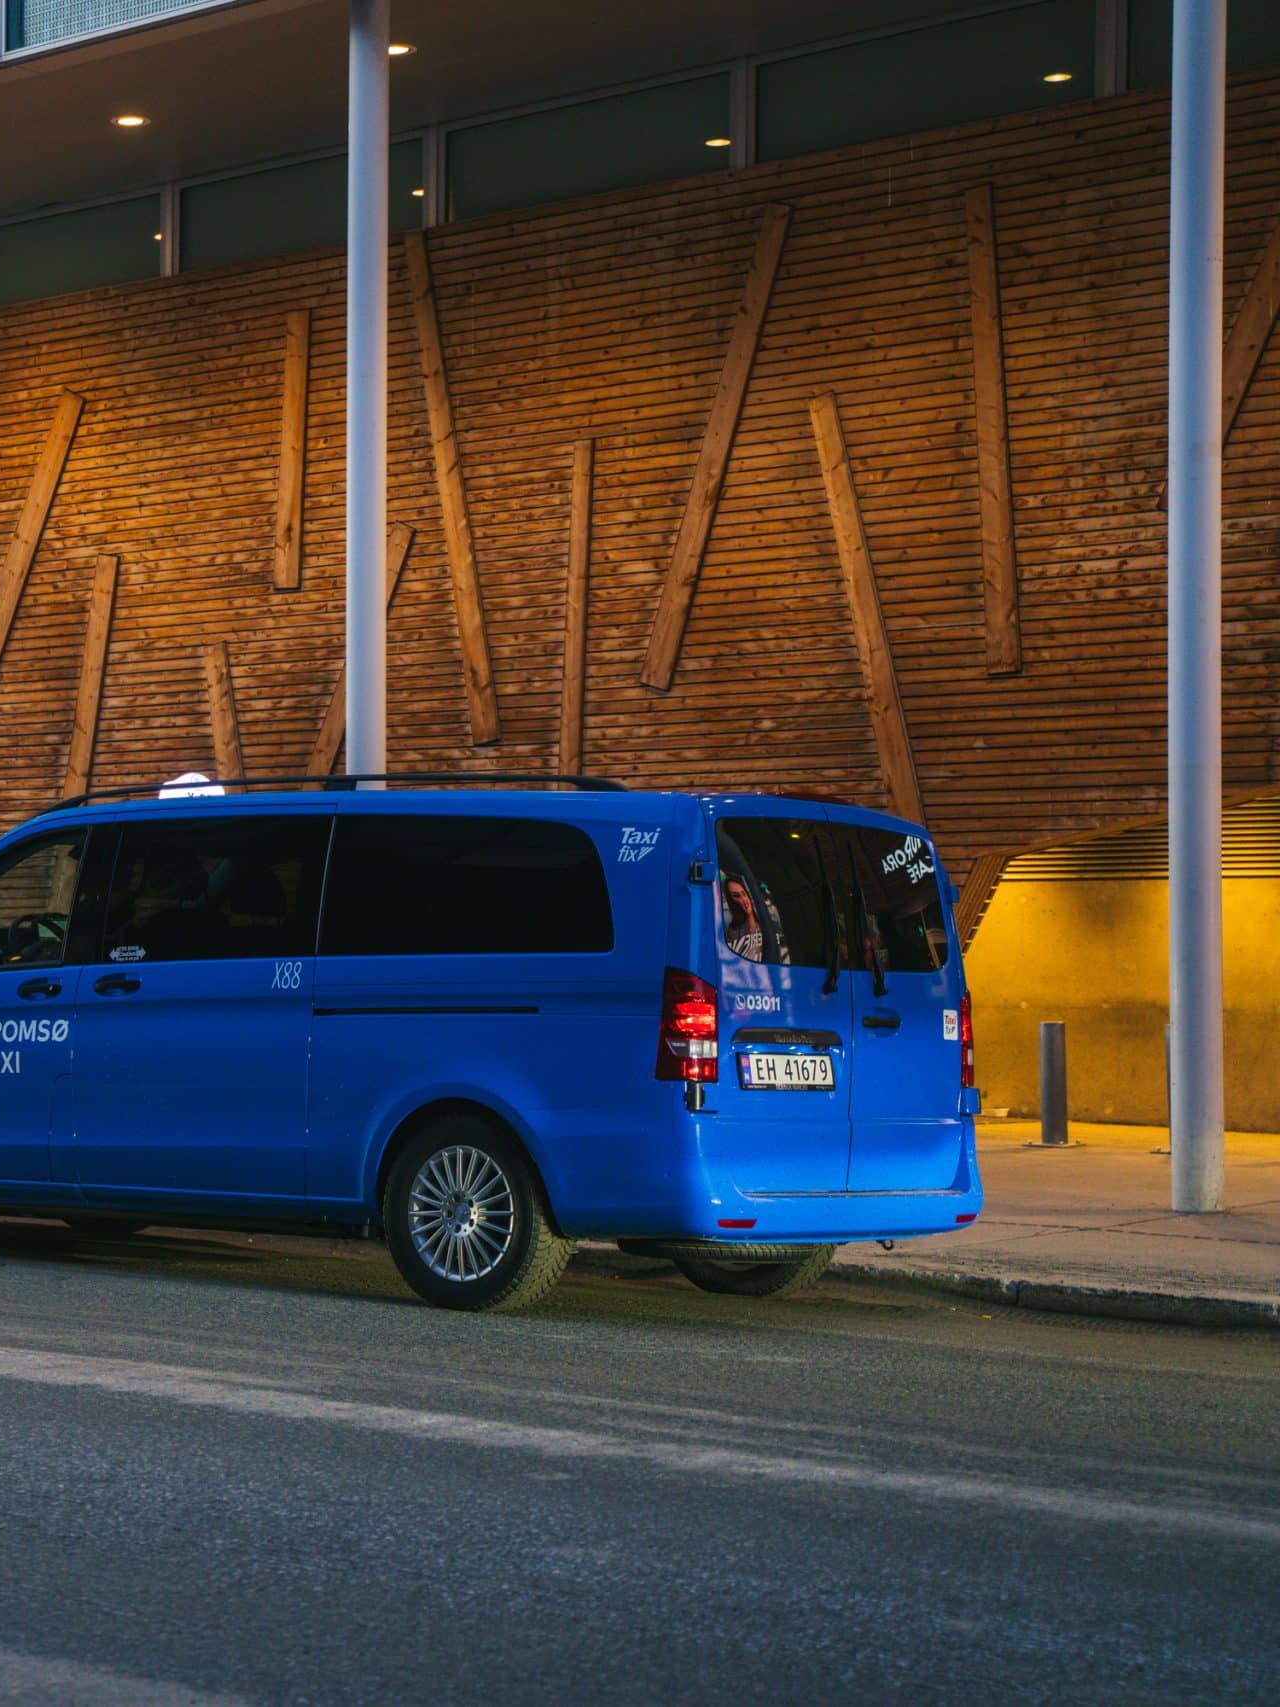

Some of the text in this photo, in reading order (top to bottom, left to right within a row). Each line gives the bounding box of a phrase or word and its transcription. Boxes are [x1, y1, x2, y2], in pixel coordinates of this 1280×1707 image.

[621, 827, 662, 844] Taxi
[617, 845, 639, 863] fix
[271, 961, 303, 990] X88
[747, 995, 781, 1012] 03011
[755, 1058, 828, 1081] EH 41679
